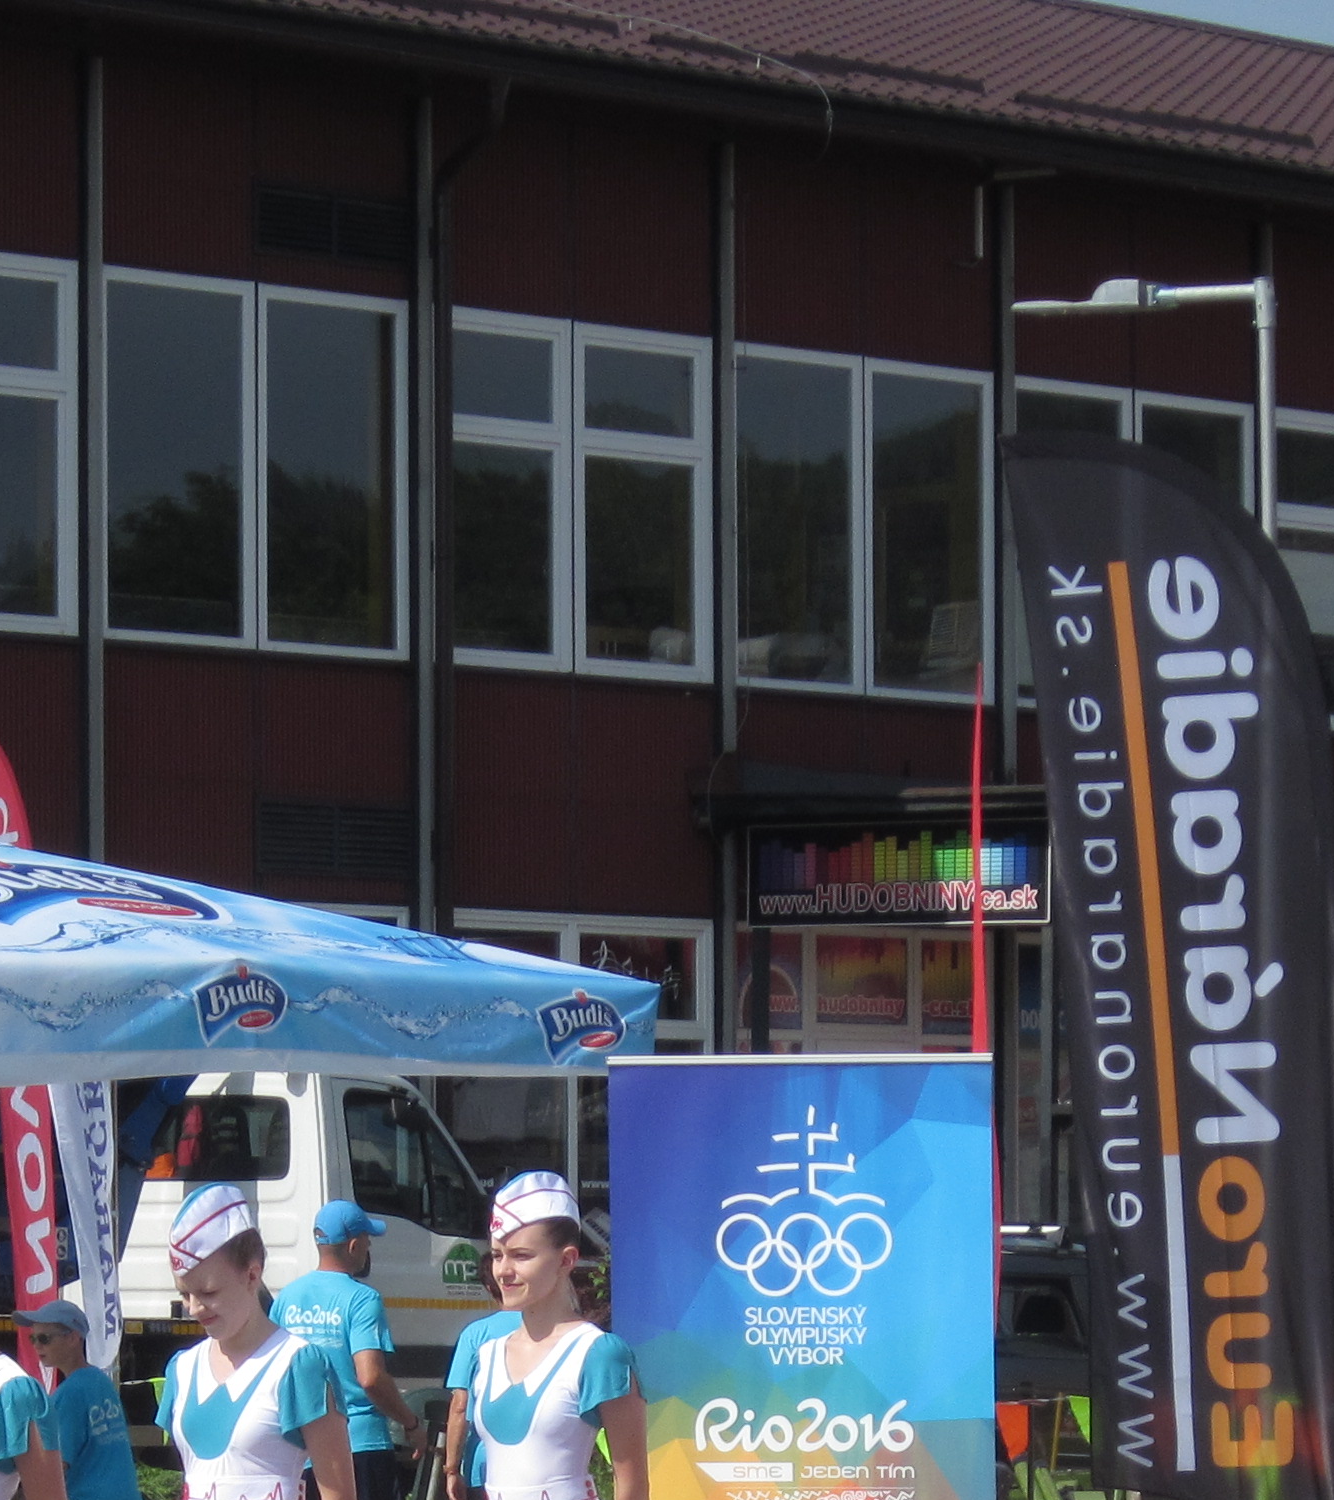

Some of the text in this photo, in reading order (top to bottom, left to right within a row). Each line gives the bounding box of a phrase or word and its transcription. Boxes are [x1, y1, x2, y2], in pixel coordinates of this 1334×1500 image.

[744, 1304, 867, 1326] SLOVENSKÝ
[745, 1324, 867, 1345] OLYMPIJSKÝ
[769, 1344, 844, 1365] VÝBOR
[801, 1465, 869, 1479] JEDEN
[876, 1463, 915, 1479] TÍM
